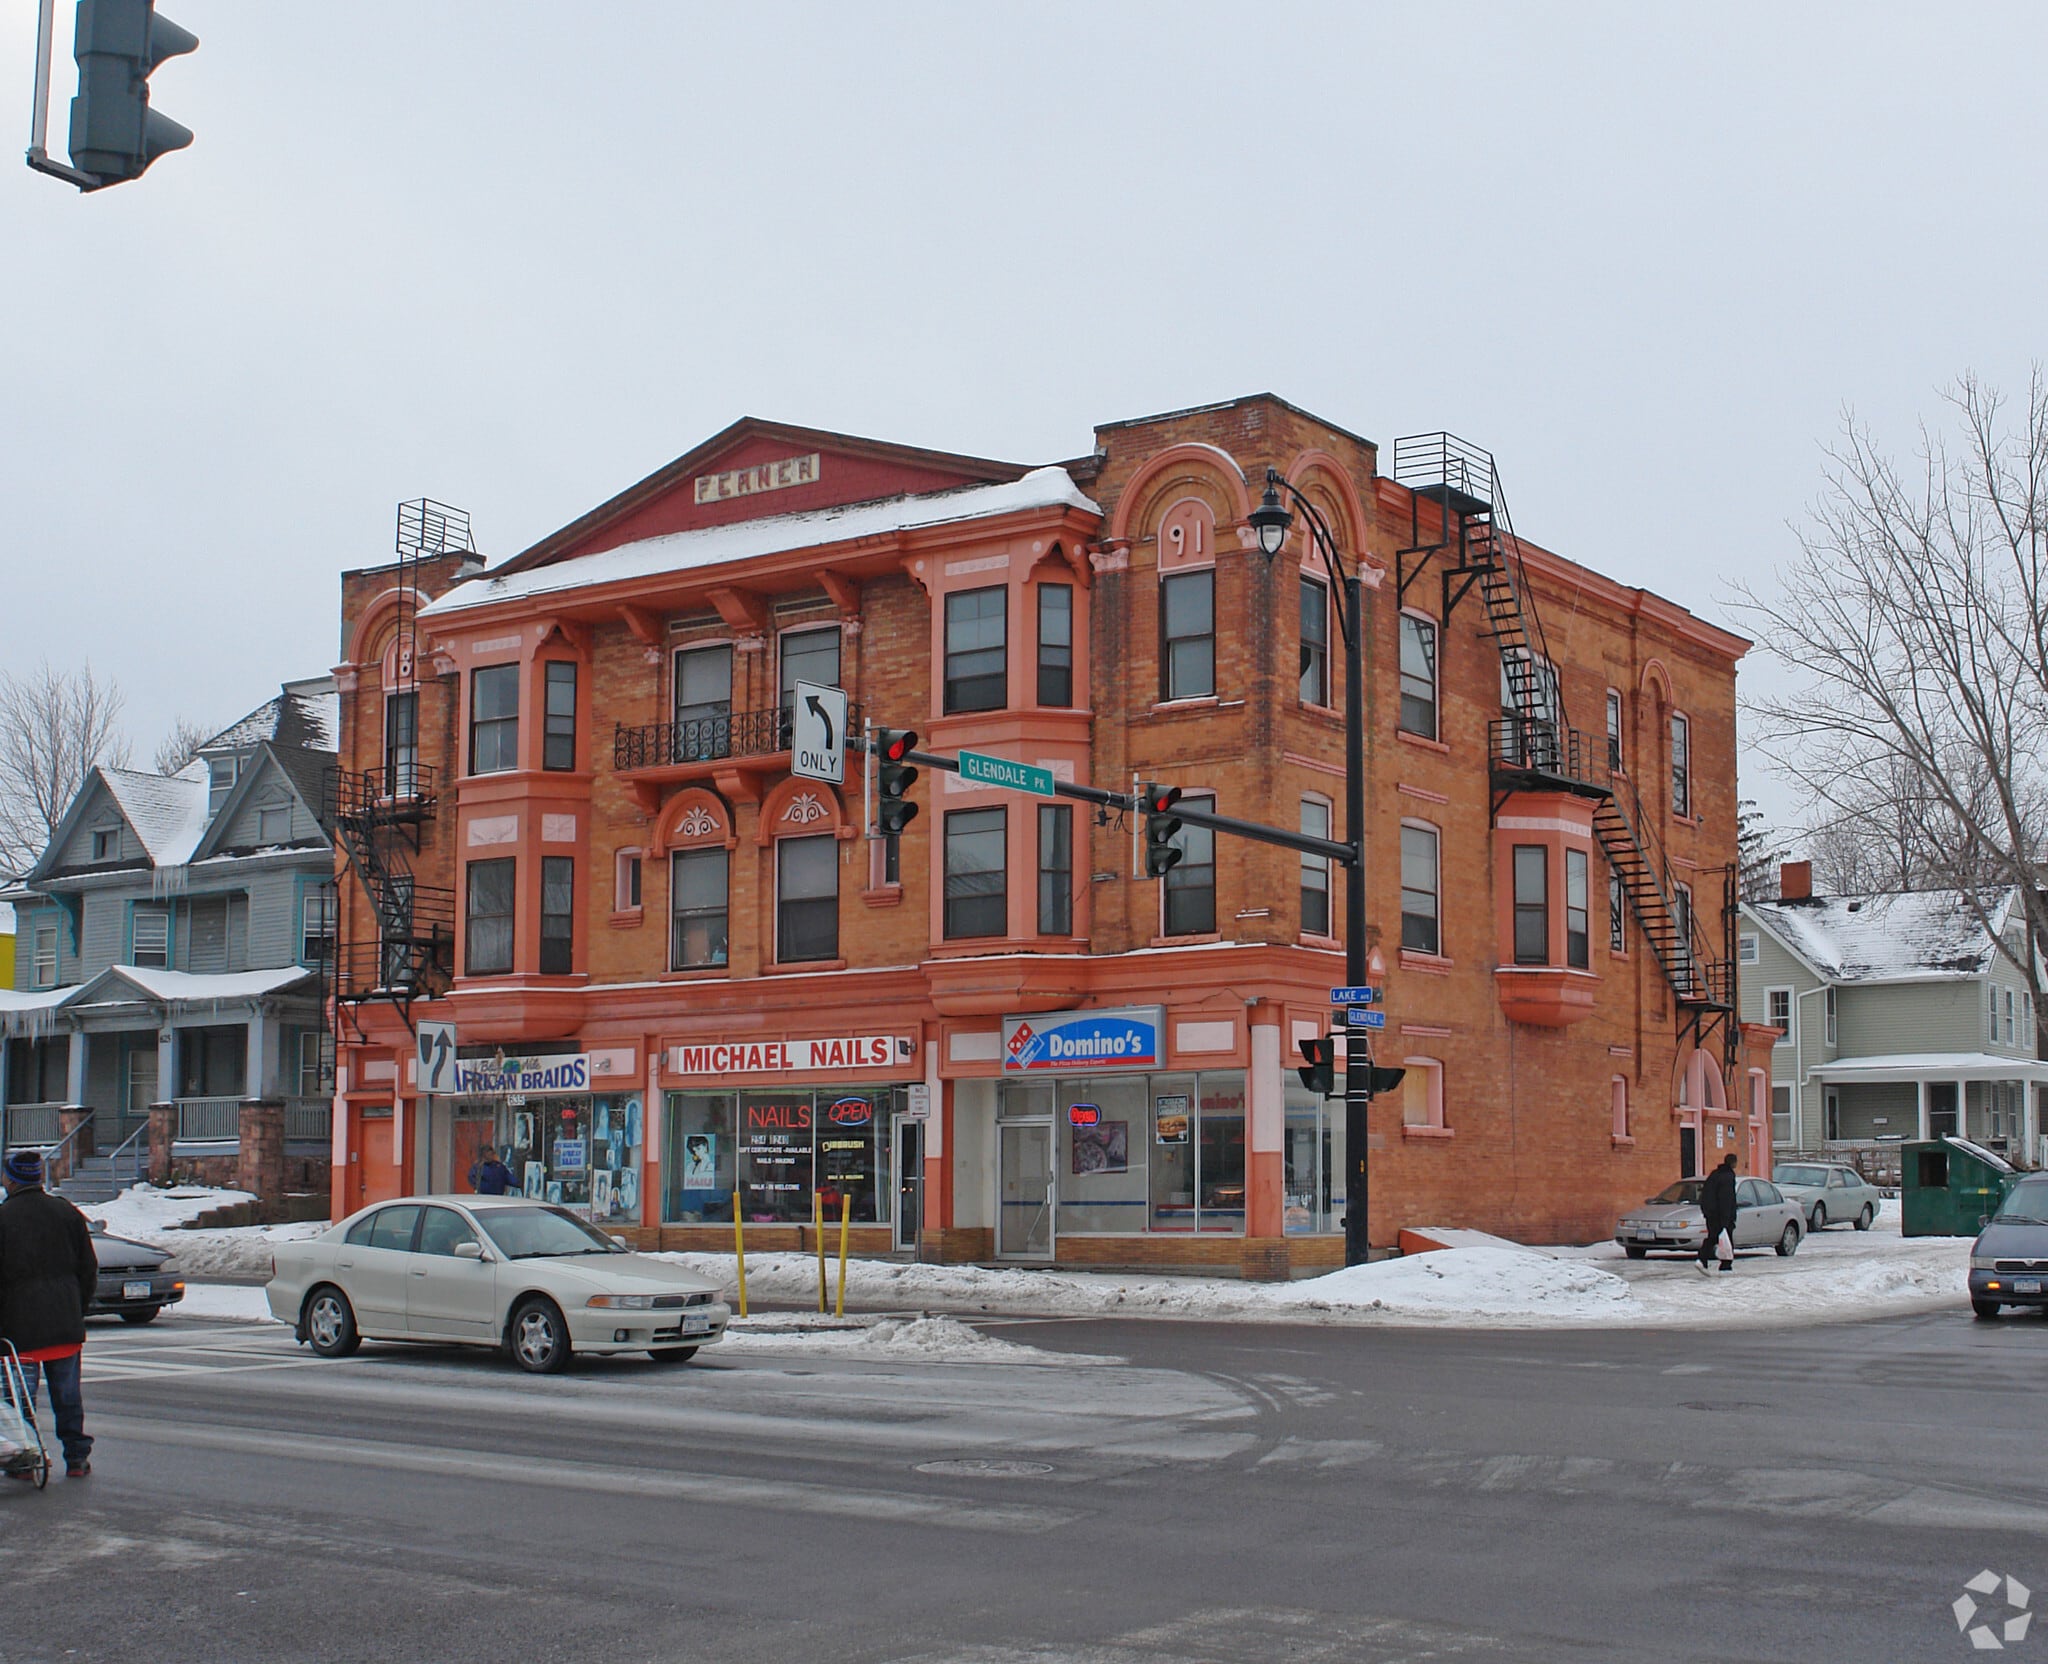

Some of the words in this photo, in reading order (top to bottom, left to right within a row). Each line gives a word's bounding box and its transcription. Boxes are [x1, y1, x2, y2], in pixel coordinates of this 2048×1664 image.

[1168, 519, 1202, 556] 91
[800, 750, 838, 774] ONLY
[968, 758, 1026, 786] GLENDALE
[1034, 777, 1046, 790] PK
[1332, 990, 1357, 1001] LAKE
[1350, 1011, 1378, 1024] GLENDALE
[683, 1044, 793, 1073] MICHAEL
[810, 1038, 888, 1067] NAILS
[1049, 1030, 1142, 1057] Domino's
[521, 1058, 585, 1090] BRAIDS
[748, 1105, 811, 1128] NAILS
[829, 1103, 872, 1121] OPEN
